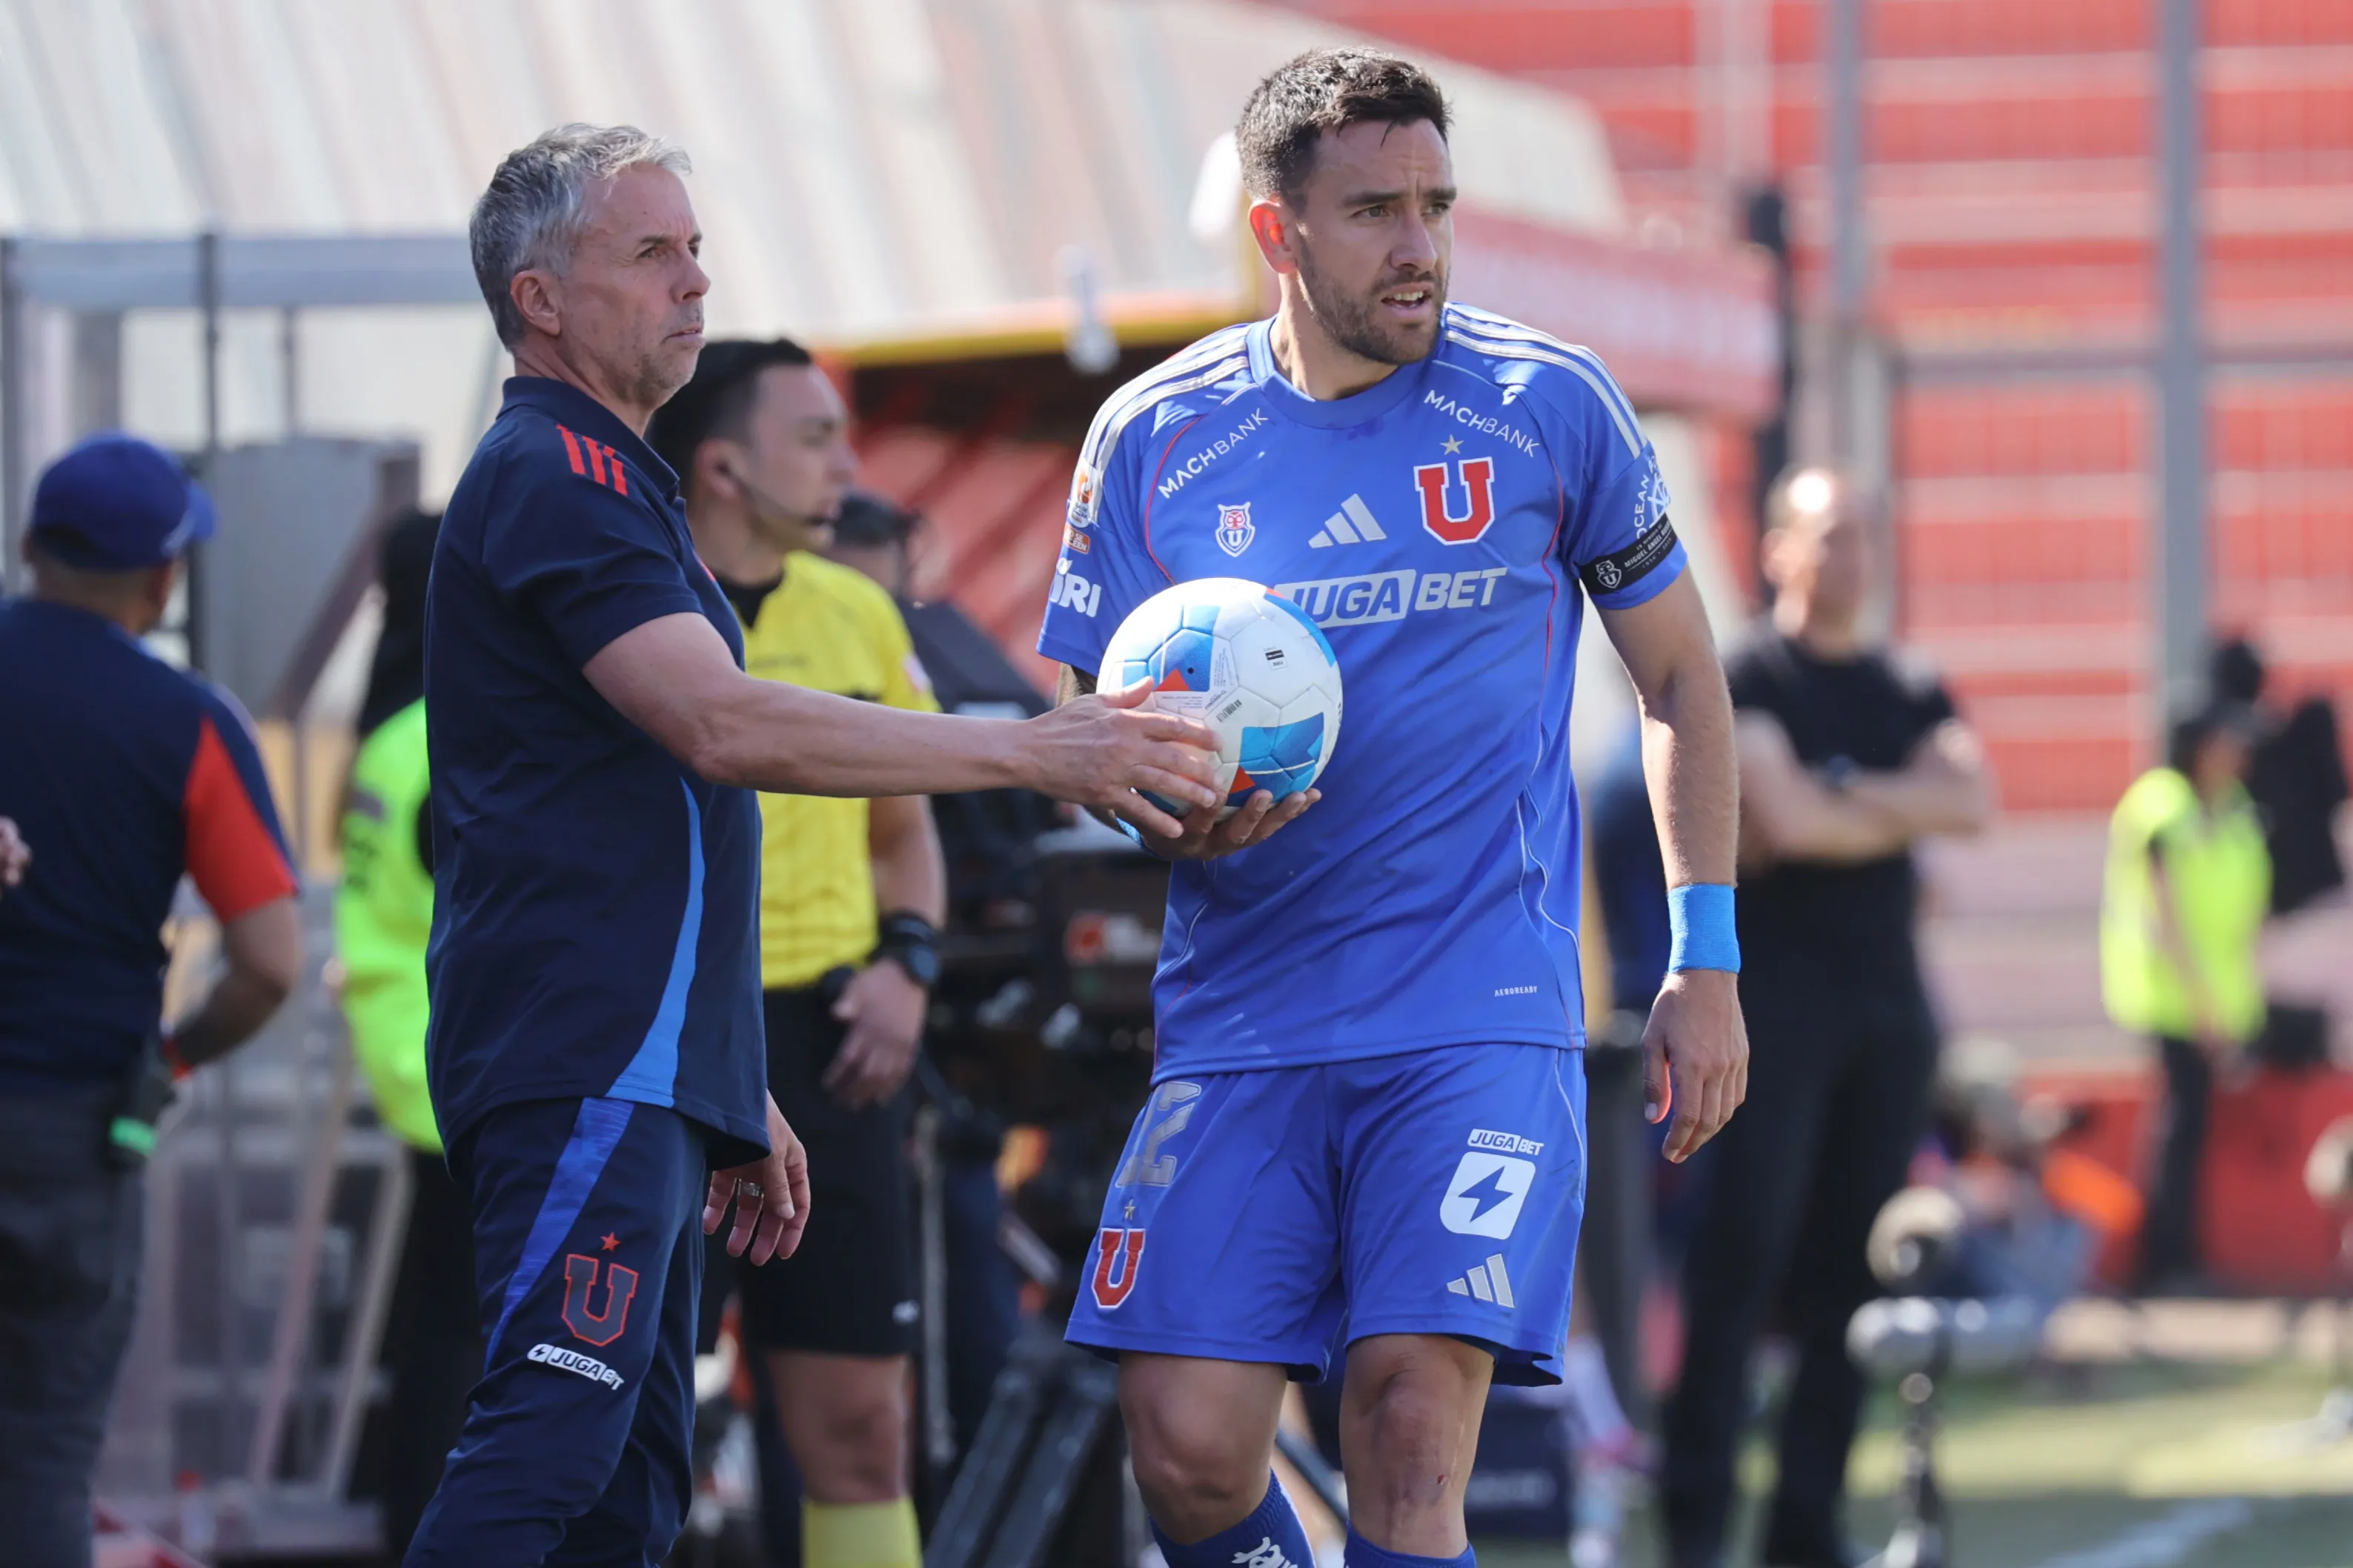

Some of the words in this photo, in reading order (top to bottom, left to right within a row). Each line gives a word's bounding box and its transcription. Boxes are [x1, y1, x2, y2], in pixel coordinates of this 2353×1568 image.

[1158, 407, 1270, 499] MACHBANK
[1423, 389, 1541, 458] MACHBANK
[1413, 456, 1496, 546] U
[1227, 529, 1244, 547] U
[1624, 548, 1648, 568] MIGUEL
[1603, 572, 1617, 585] U
[1494, 985, 1539, 997] AEROREADY
[561, 1253, 640, 1346] U
[1091, 1227, 1146, 1309] U
